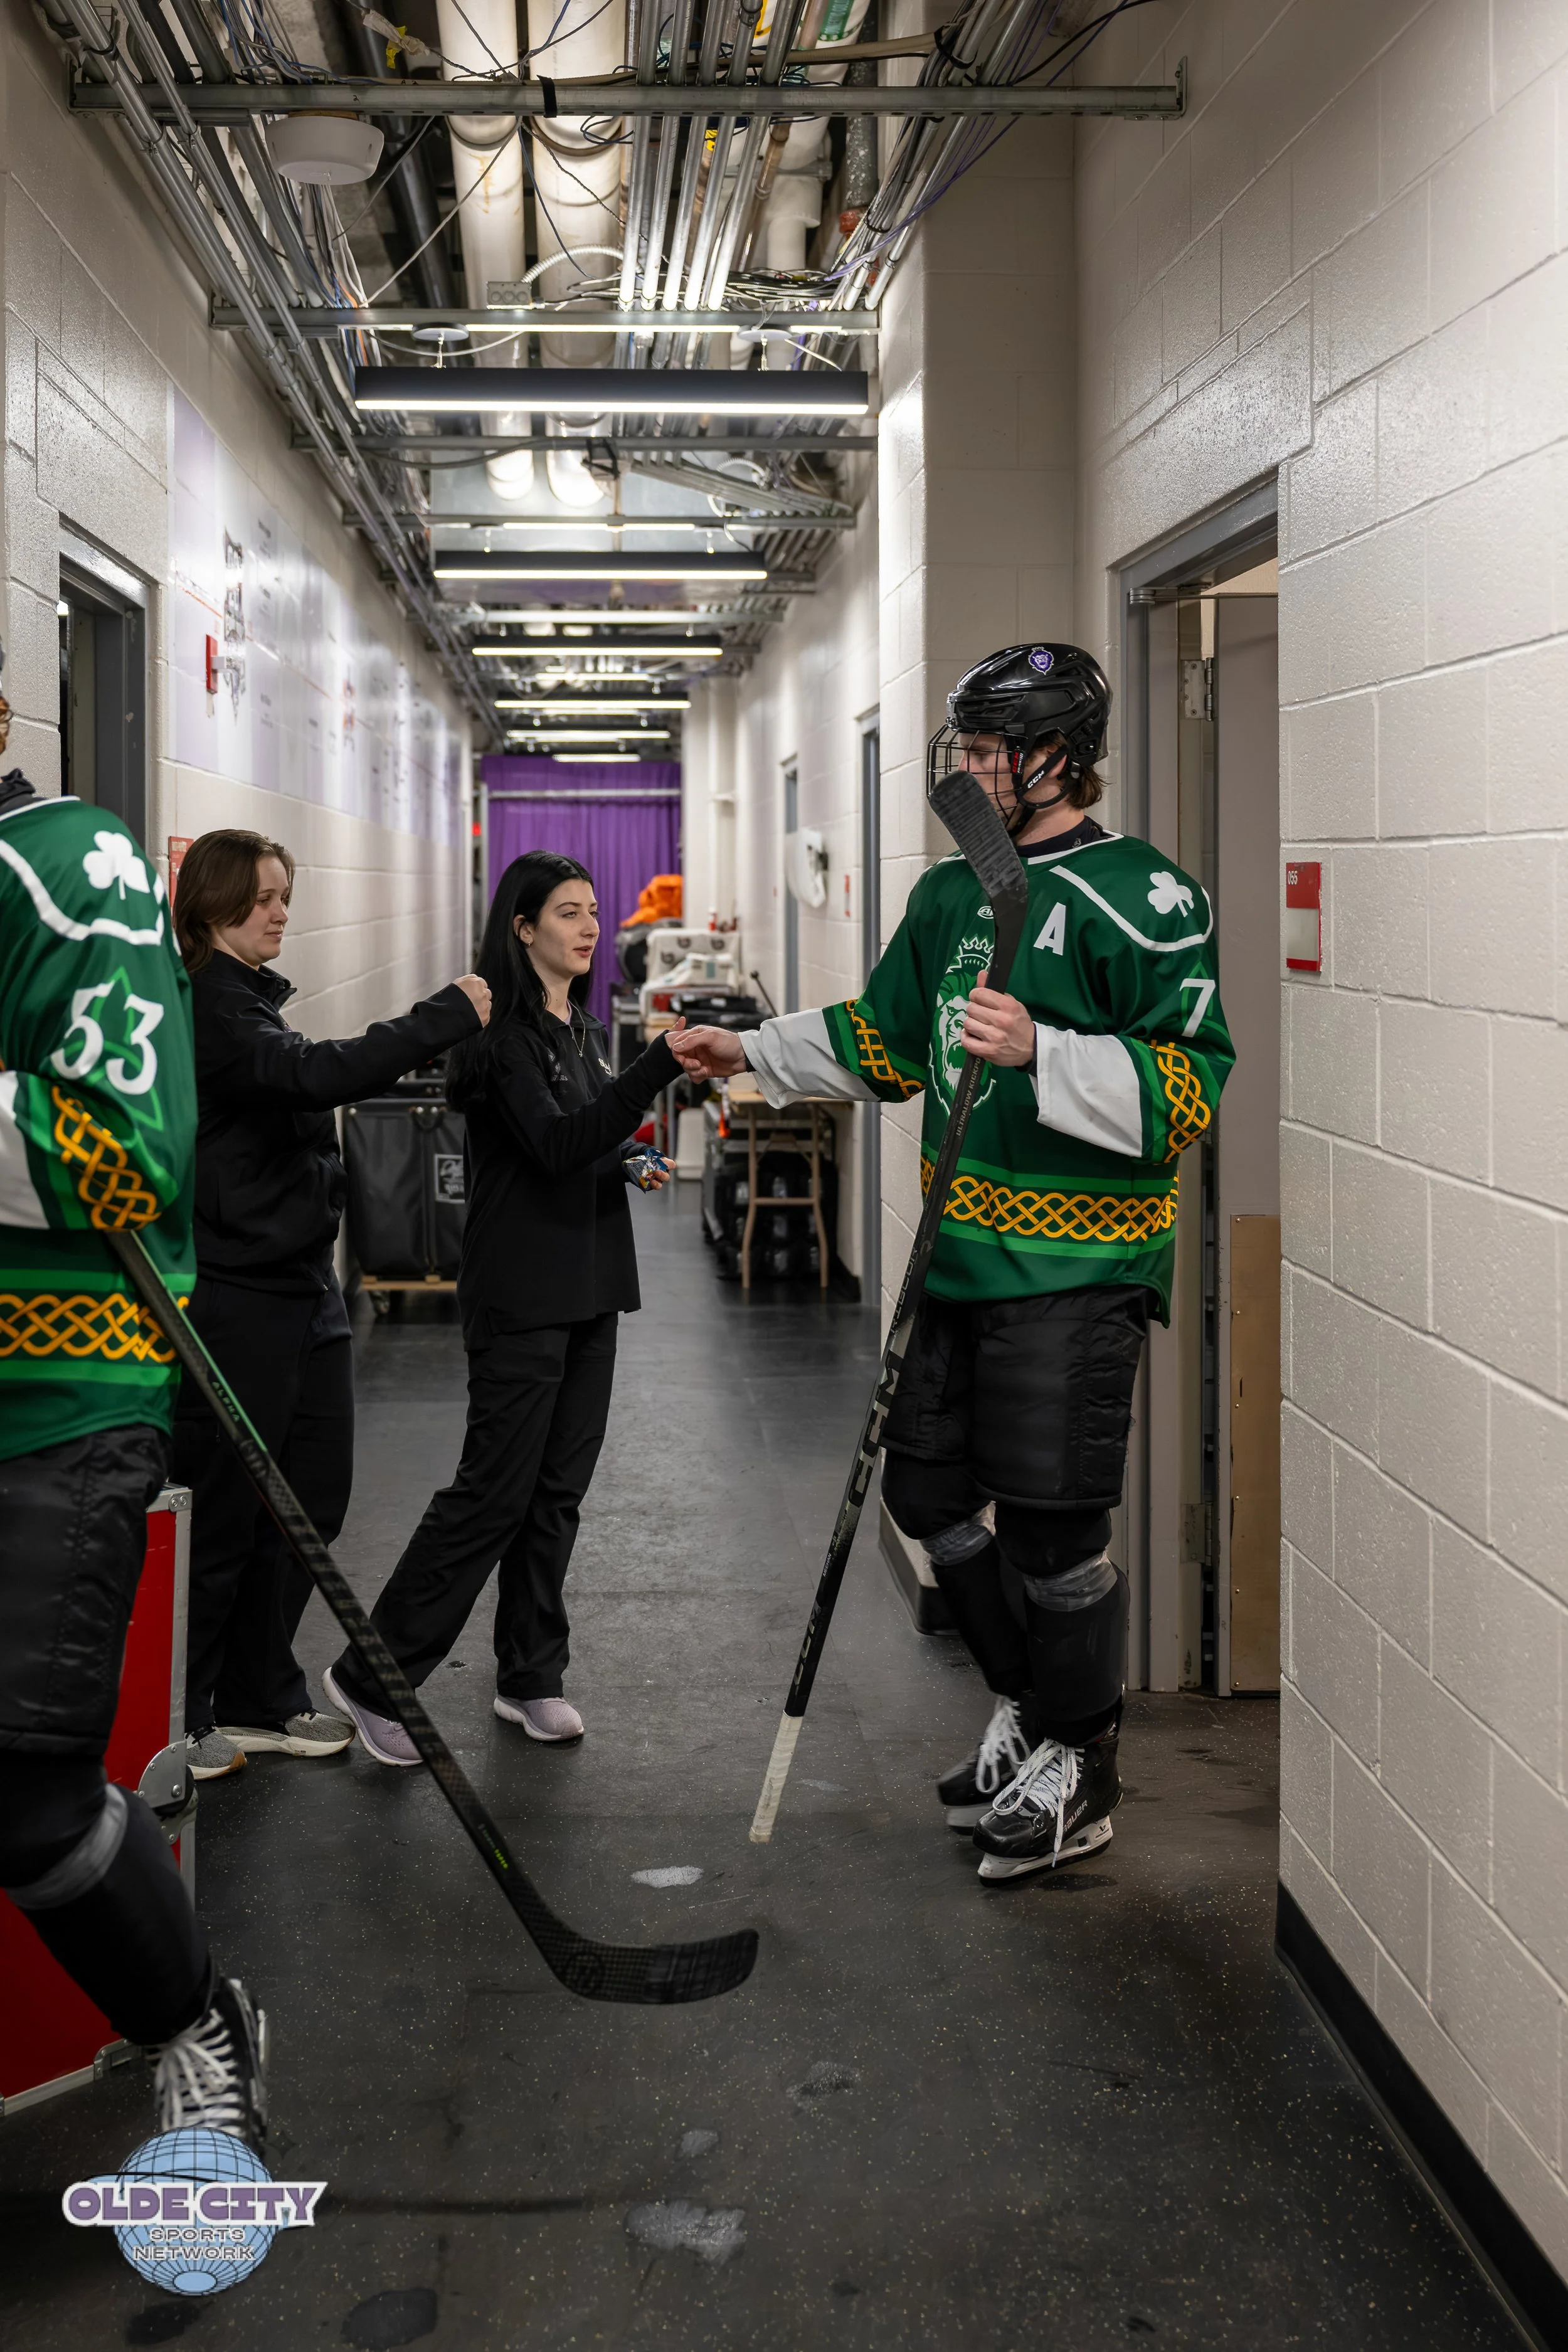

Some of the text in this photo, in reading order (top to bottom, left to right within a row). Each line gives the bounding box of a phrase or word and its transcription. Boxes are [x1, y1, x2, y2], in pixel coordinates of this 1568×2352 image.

[1027, 770, 1044, 788] CCM
[1288, 871, 1298, 885] 055
[1033, 902, 1066, 956] A
[1179, 978, 1216, 1037] 7
[50, 980, 164, 1095] 53
[956, 1057, 982, 1136] ULTRALOW KICKPO
